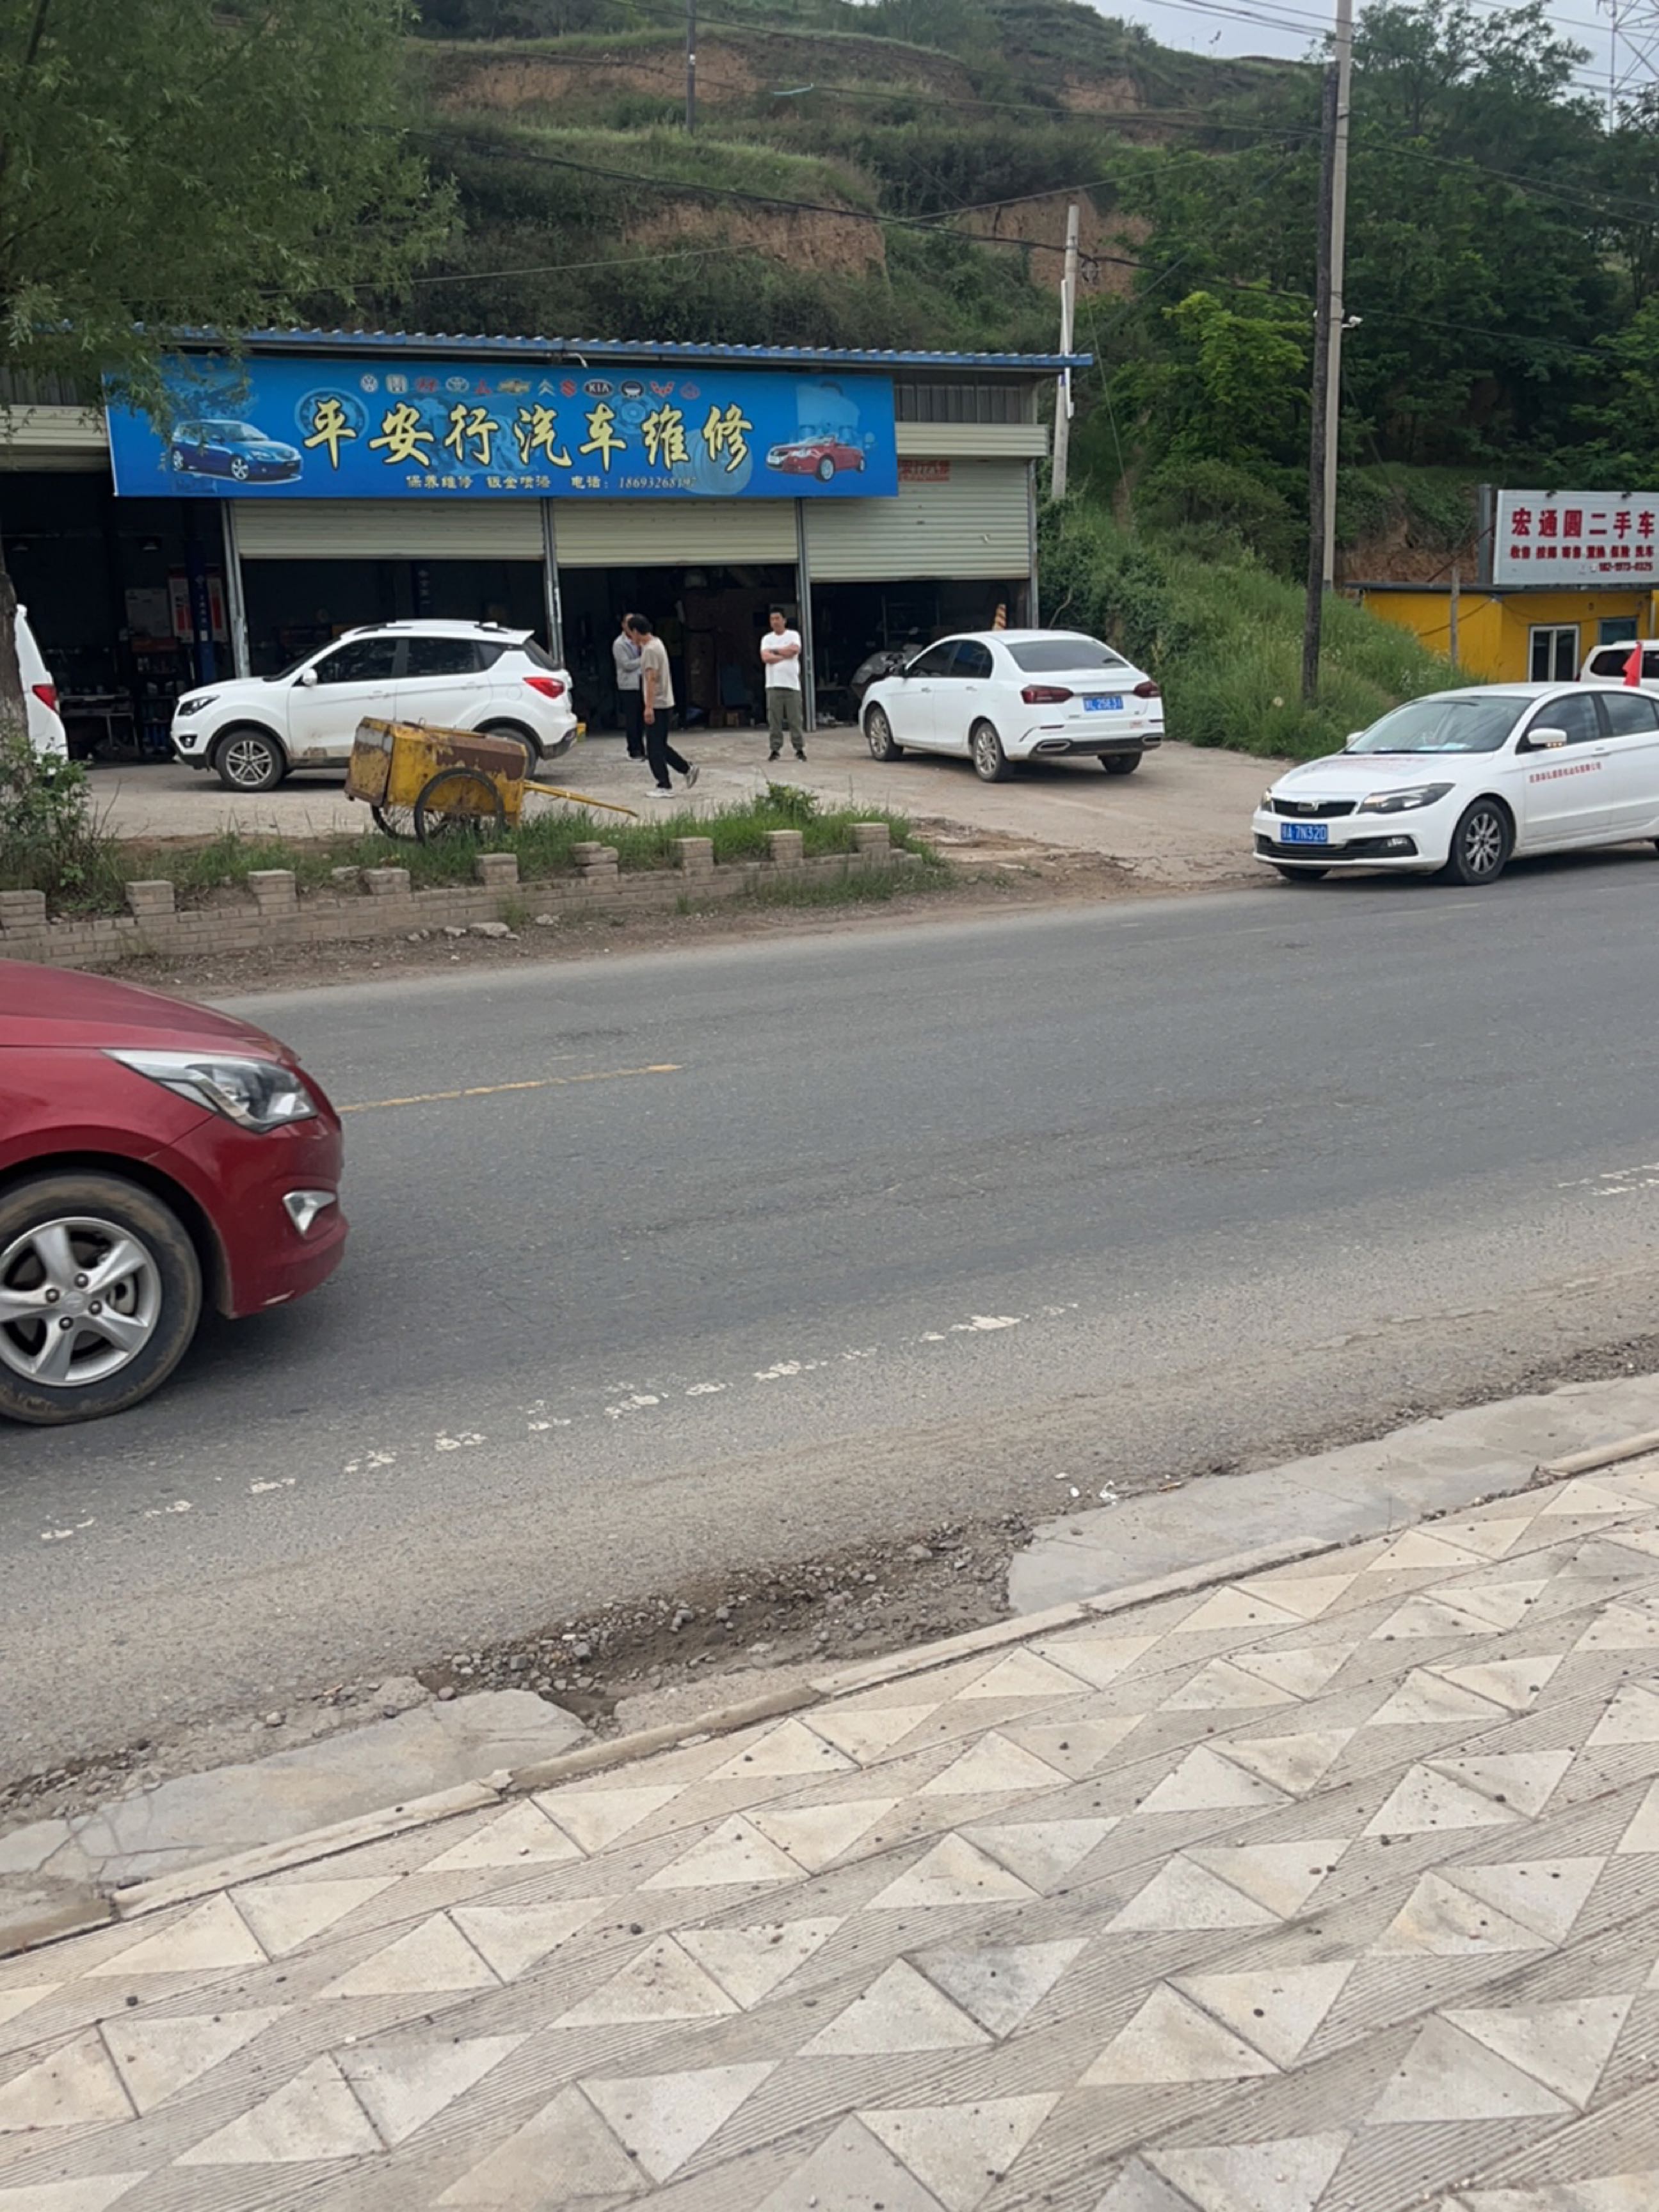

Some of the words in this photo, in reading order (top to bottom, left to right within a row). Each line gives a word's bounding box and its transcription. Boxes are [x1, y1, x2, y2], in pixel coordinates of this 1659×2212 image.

[303, 397, 753, 472] 平安行汽车维修
